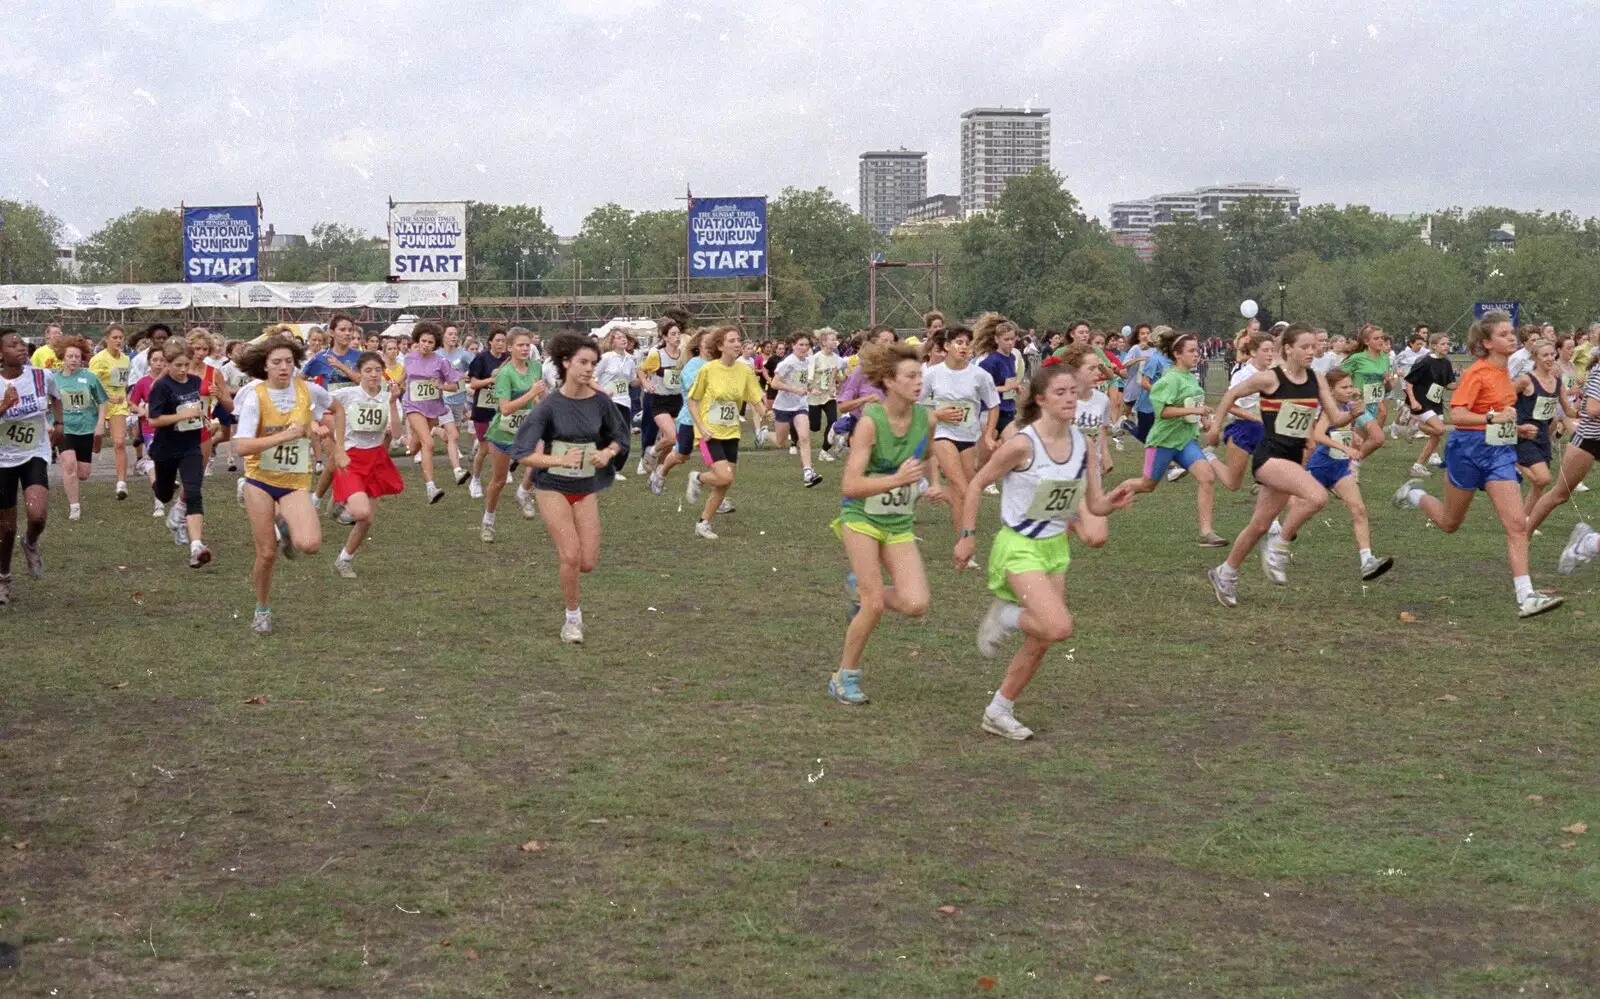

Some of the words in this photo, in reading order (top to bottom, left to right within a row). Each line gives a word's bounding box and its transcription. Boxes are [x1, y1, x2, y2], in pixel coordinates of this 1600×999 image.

[394, 222, 461, 235] NATIONAL
[692, 217, 762, 230] NATIONAL
[187, 226, 253, 238] NATIONAL
[697, 230, 726, 243] FUN
[728, 229, 756, 242] RUN
[192, 238, 219, 250] FUN
[221, 238, 248, 250] RUN
[398, 235, 426, 247] FUN
[428, 234, 456, 247] RUN
[188, 257, 255, 277] START
[394, 255, 462, 273] START
[693, 250, 763, 270] START
[417, 383, 435, 396] 276
[615, 382, 627, 394] 122
[20, 394, 36, 405] THE
[69, 394, 84, 406] 141
[7, 402, 38, 418] ADNESS
[357, 408, 382, 425] 349
[720, 406, 735, 420] 125
[508, 414, 527, 429] 30
[6, 424, 35, 444] 456
[273, 445, 299, 465] 415
[1044, 487, 1077, 511] 251
